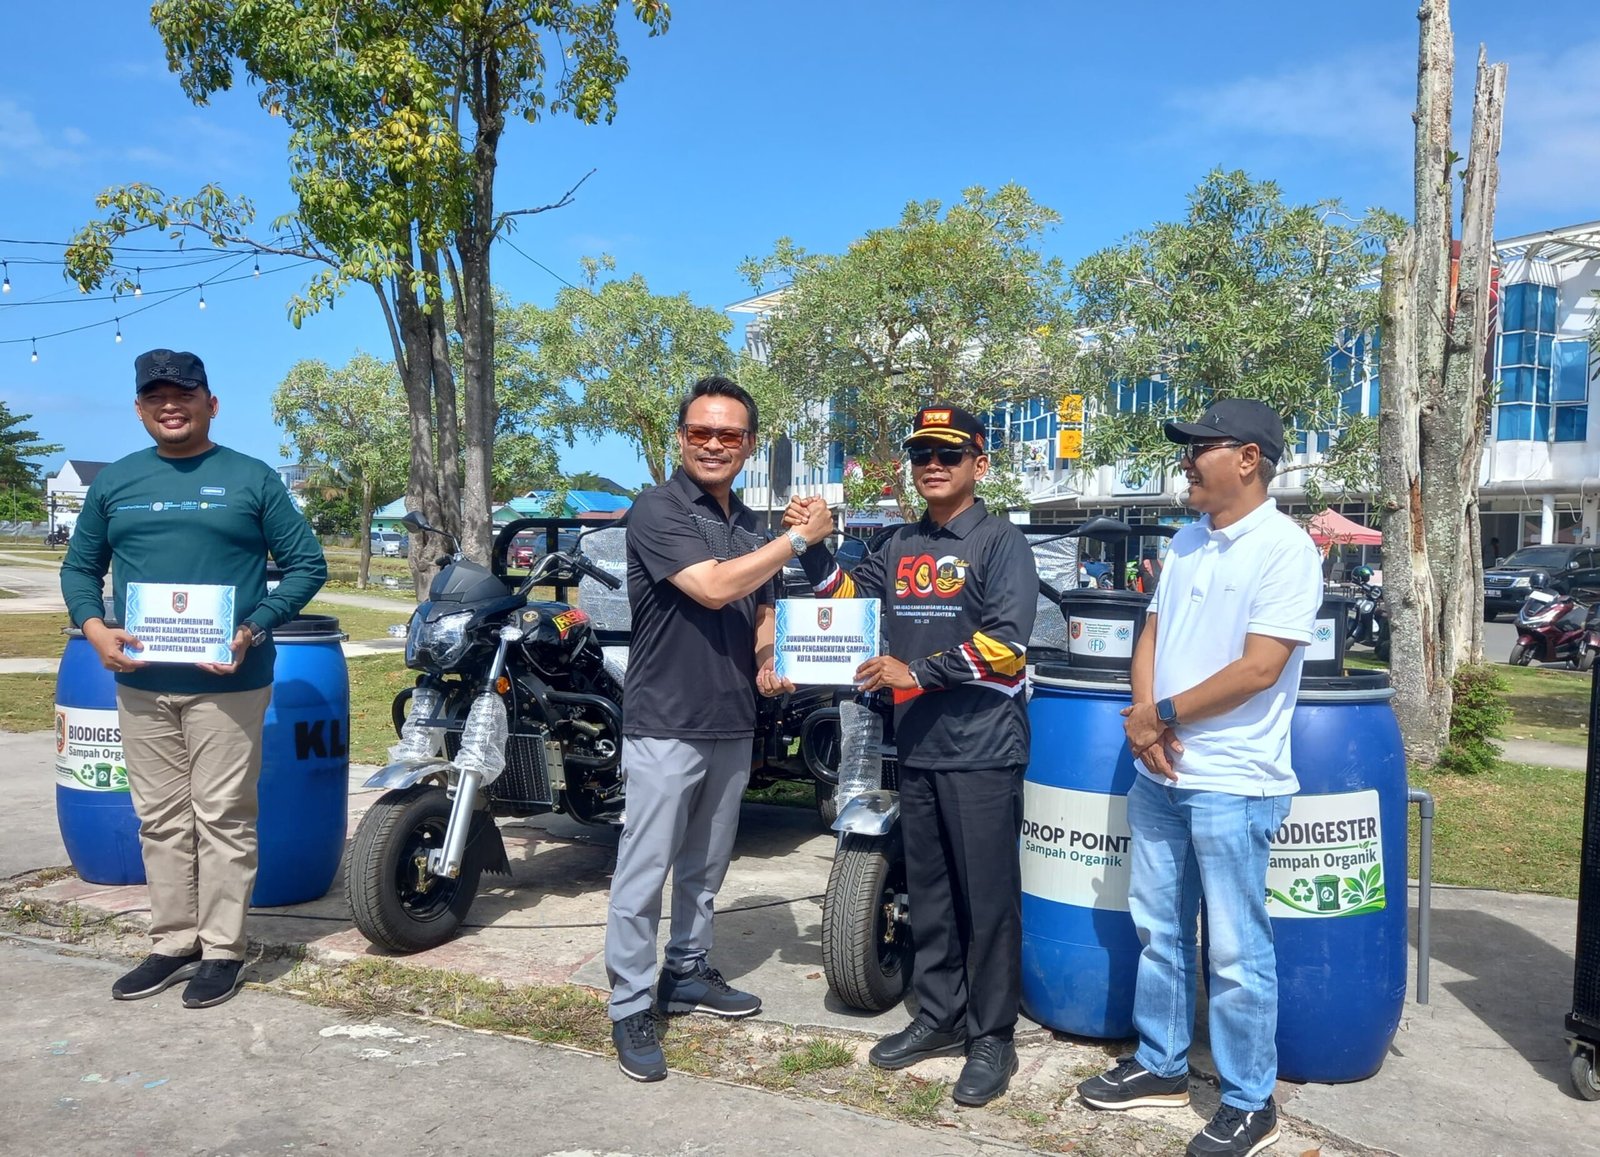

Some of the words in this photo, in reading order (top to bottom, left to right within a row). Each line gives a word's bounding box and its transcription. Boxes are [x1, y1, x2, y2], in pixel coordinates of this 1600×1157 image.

[896, 553, 966, 599] 500
[144, 617, 177, 625] DUKUNGAN
[178, 618, 214, 626] PEMERINTAH
[200, 627, 224, 635] SELATAN
[155, 635, 200, 643] PENGANGKUTAN
[184, 645, 206, 653] BANJAR
[811, 655, 852, 663] BANJARMASIN
[68, 745, 100, 759] Sampah
[1022, 819, 1065, 844] DROP
[1069, 830, 1132, 854] POINT
[1025, 840, 1066, 859] Sampah
[1069, 850, 1122, 867] Organik
[1268, 854, 1320, 871] ampah
[1323, 848, 1377, 870] Organik
